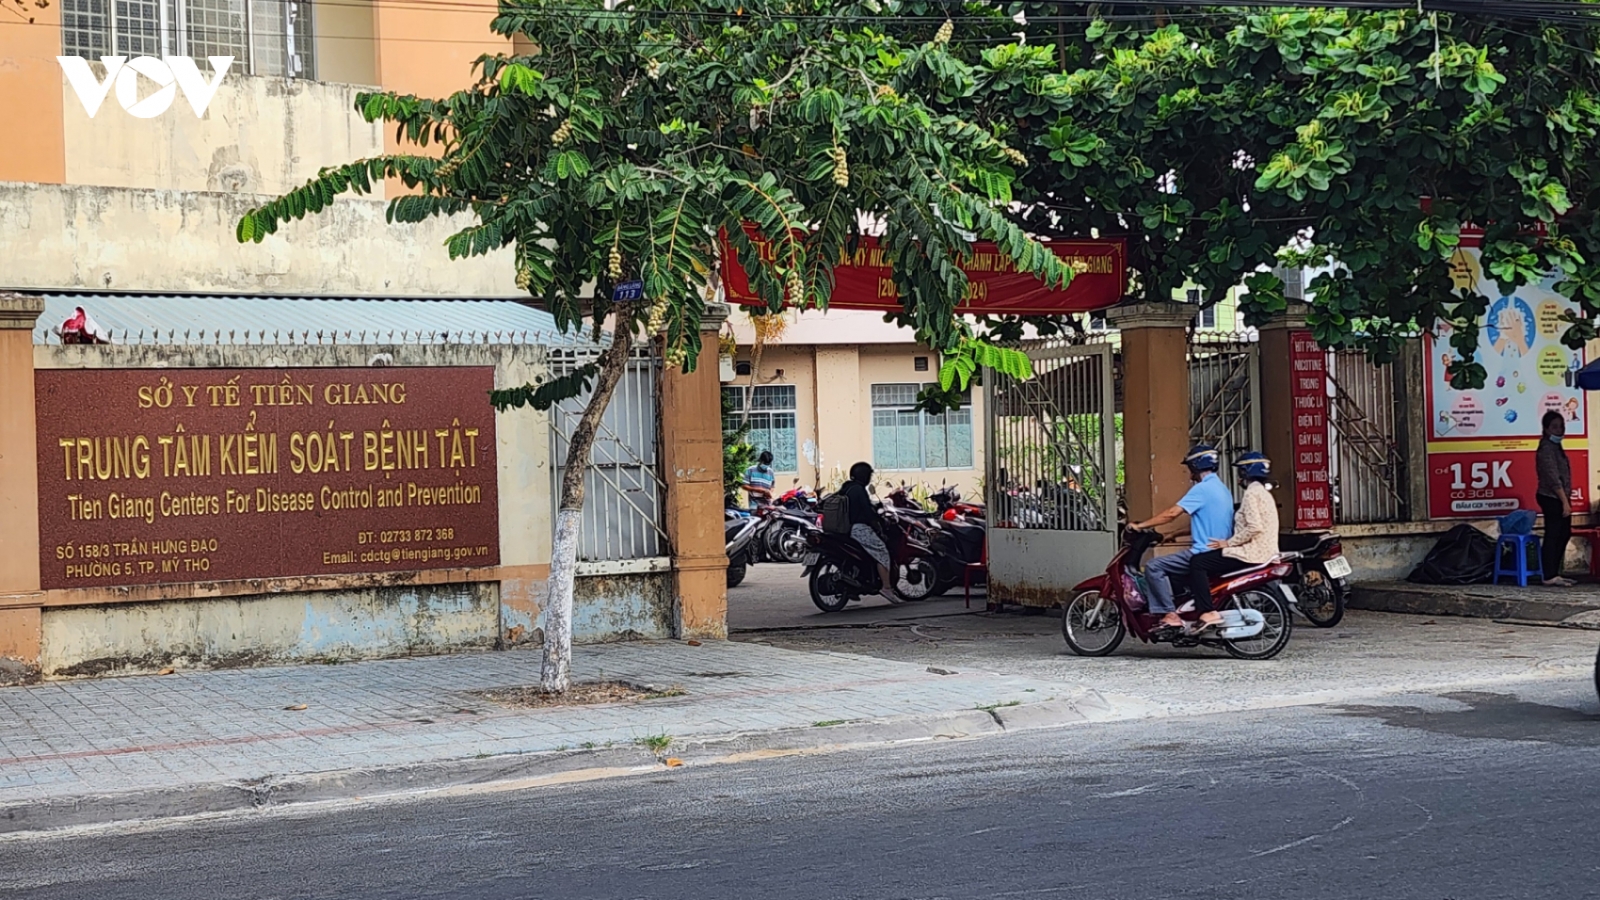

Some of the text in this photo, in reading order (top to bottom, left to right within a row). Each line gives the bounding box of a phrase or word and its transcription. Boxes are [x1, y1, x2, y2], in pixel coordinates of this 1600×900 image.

[1087, 255, 1113, 274] GIANG
[619, 290, 635, 299] 113
[1294, 359, 1322, 371] NICOTINE
[138, 372, 407, 409] SỞ Y TẾ TIỀN GIANG
[1299, 377, 1320, 390] TRONG
[1294, 392, 1324, 408] THUỐC LÁ
[1297, 413, 1313, 429] ĐIỆN
[59, 410, 479, 480] TRUNG TÂM KIỂM SOÁT BỆNH TẬT
[1312, 433, 1323, 447] HẠI
[1300, 452, 1313, 464] CHO
[1450, 460, 1513, 490] 15K
[1301, 487, 1314, 501] NÃO
[1467, 489, 1494, 498] 3GB
[67, 480, 481, 524] Tien Giang Centers For Disease Control and Prevention
[1316, 503, 1329, 519] NHỎ
[358, 528, 454, 544] ĐT: 02733 872 368
[56, 537, 218, 559] SỐ 158/3 TRẦN HƯNG ĐẠO
[323, 545, 488, 565] Email: cdctg@tiengiang.gov.vn
[66, 556, 210, 578] PHƯỜNG 5, TP. MỸ THO
